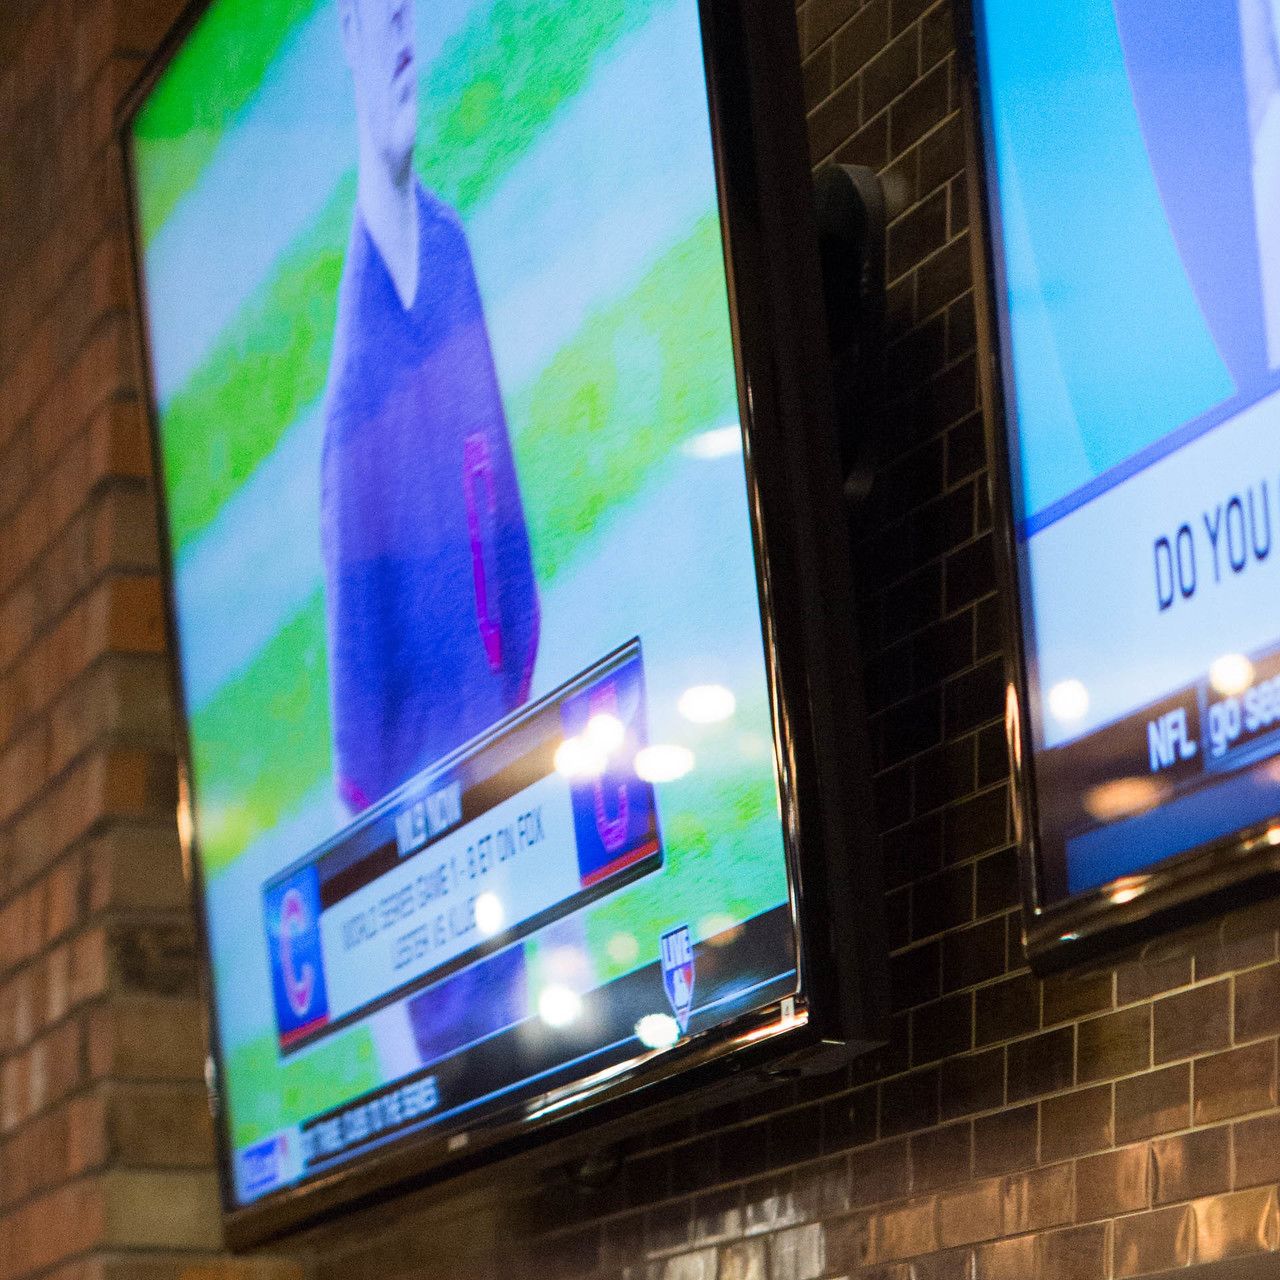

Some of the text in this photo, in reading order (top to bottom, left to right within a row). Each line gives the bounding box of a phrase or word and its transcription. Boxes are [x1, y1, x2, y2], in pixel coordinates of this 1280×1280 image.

[1153, 520, 1197, 612] DO
[1203, 479, 1273, 584] YOU
[1147, 706, 1198, 773] NFL
[517, 805, 545, 852] FOX
[661, 929, 693, 969] LIVE
